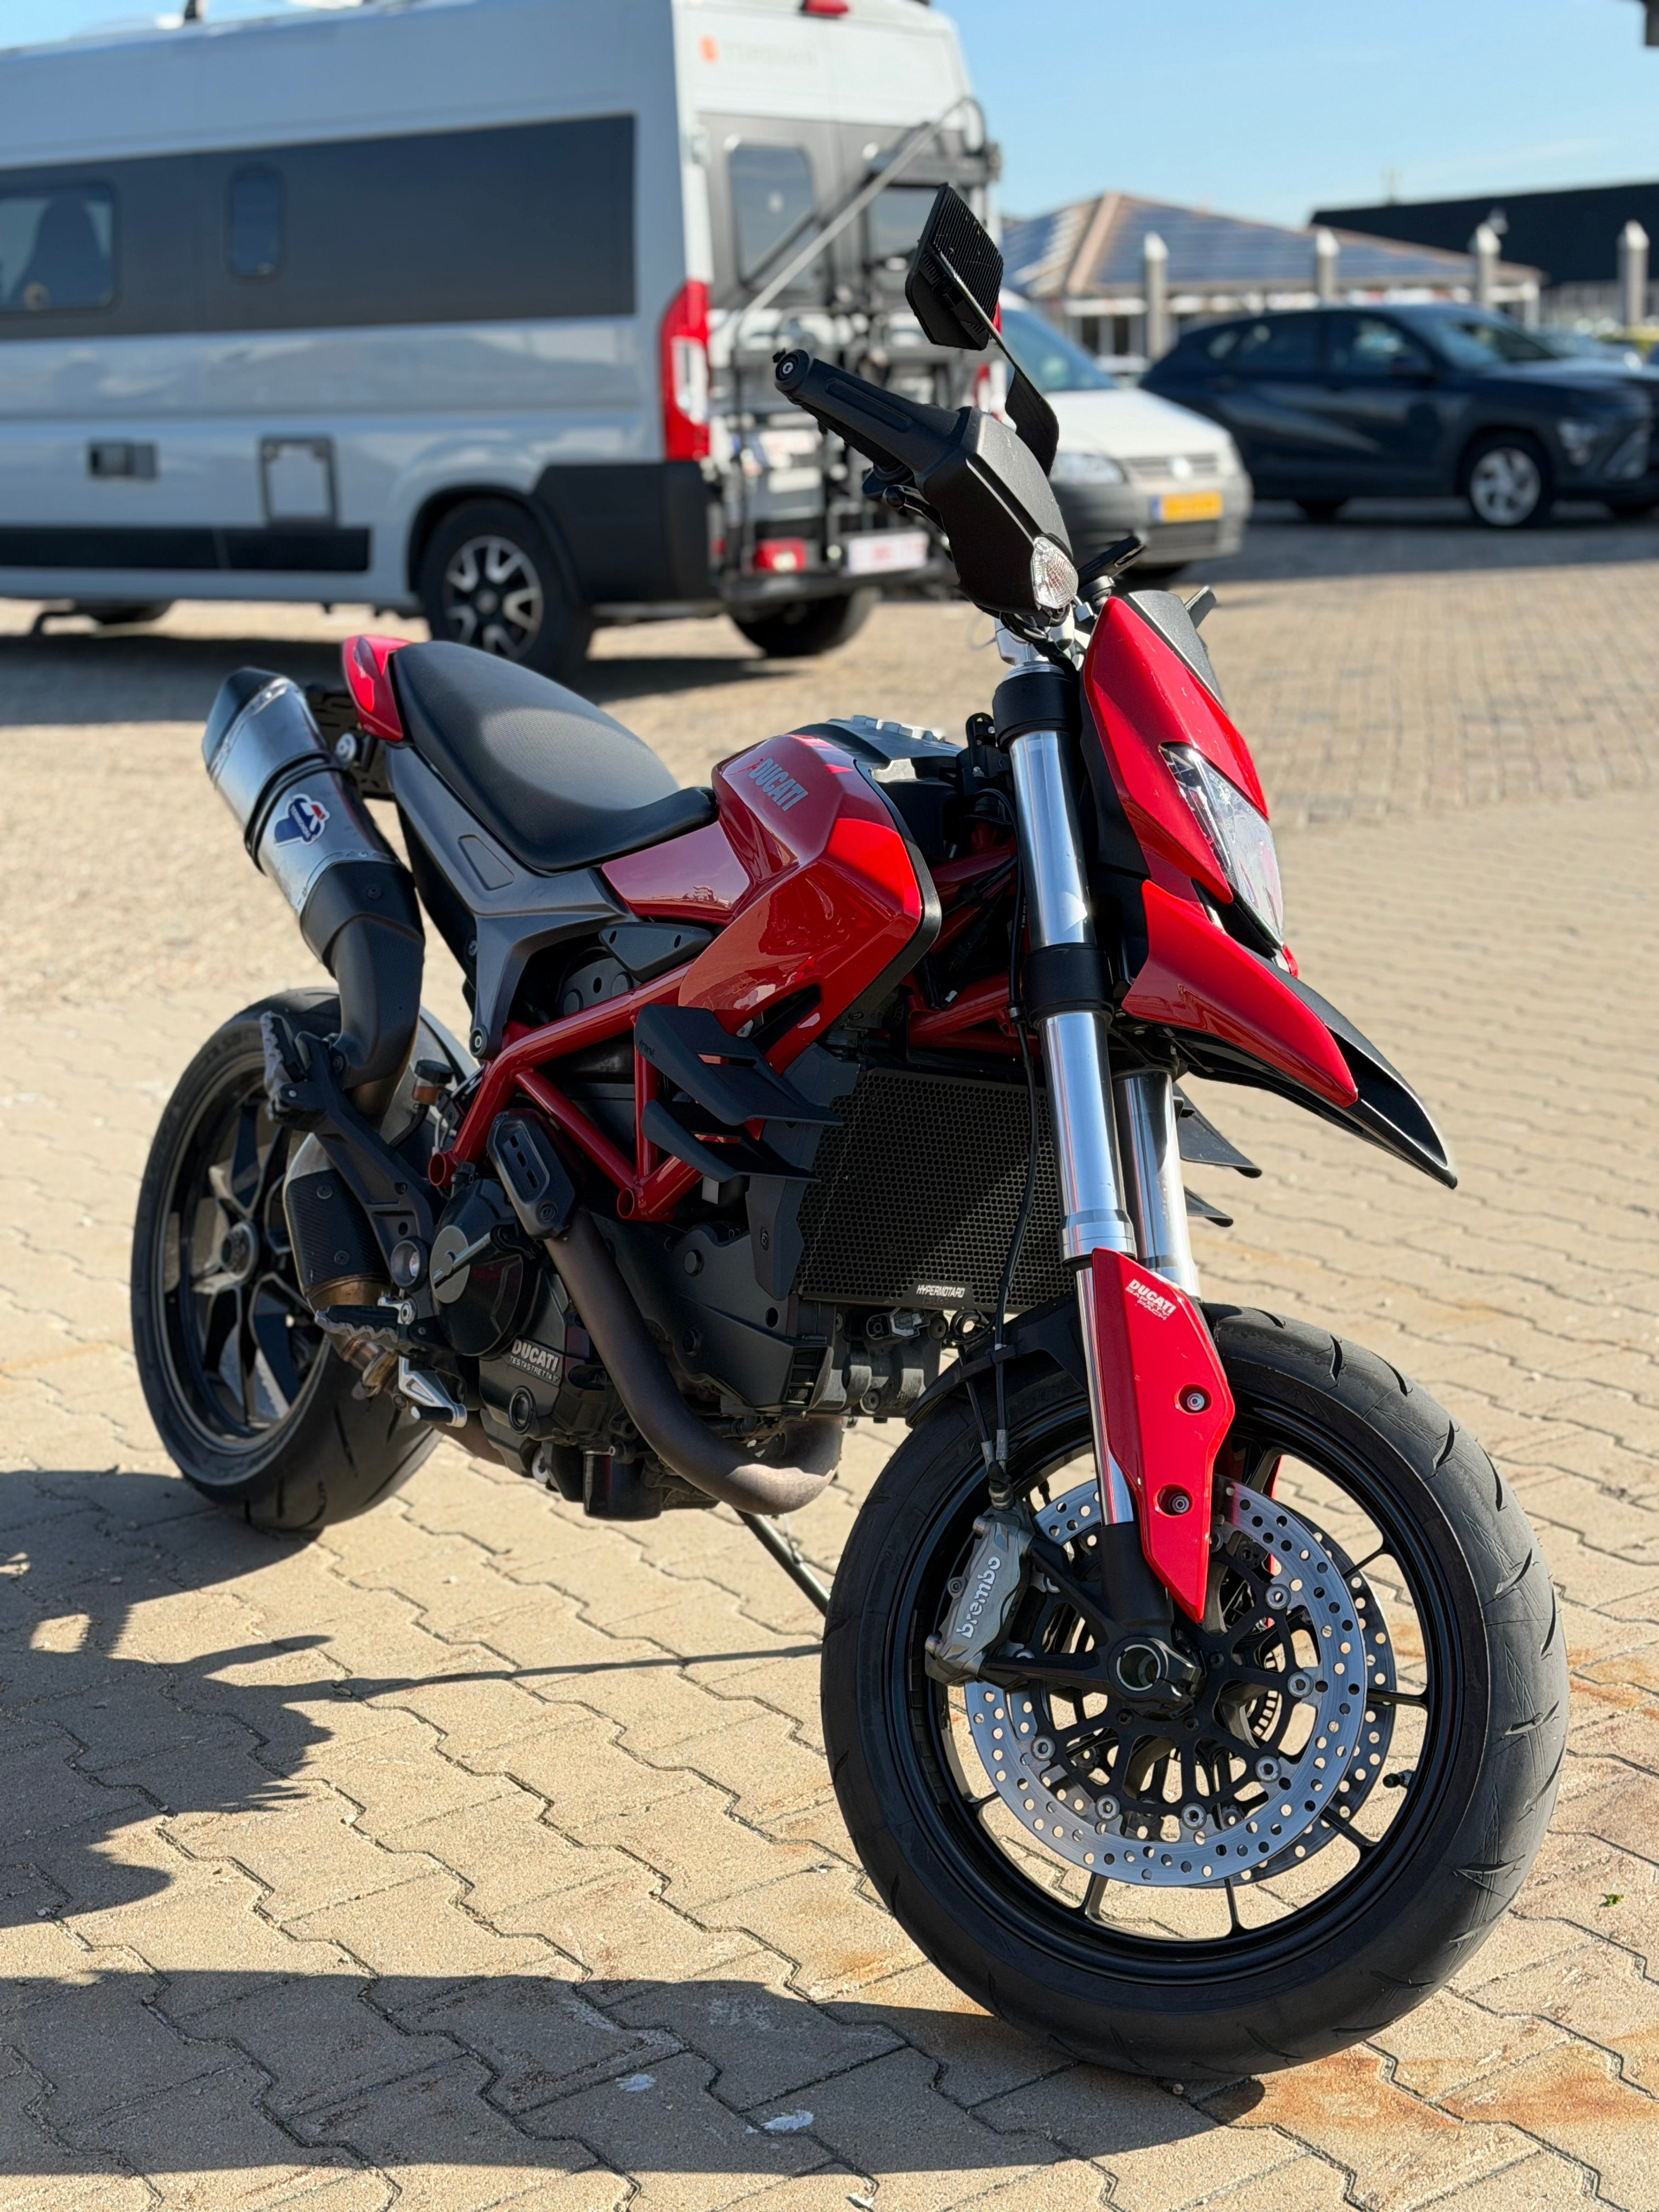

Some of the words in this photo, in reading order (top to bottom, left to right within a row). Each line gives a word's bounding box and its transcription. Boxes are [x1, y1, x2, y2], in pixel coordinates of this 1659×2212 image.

[748, 758, 809, 811] DUCATI
[916, 1284, 966, 1298] HYPERMOTARD
[1128, 1279, 1176, 1314] DUCATI
[510, 1356, 552, 1380] TESTASTRETTA
[511, 1339, 559, 1372] DUCATI
[956, 1556, 1001, 1639] brembo
